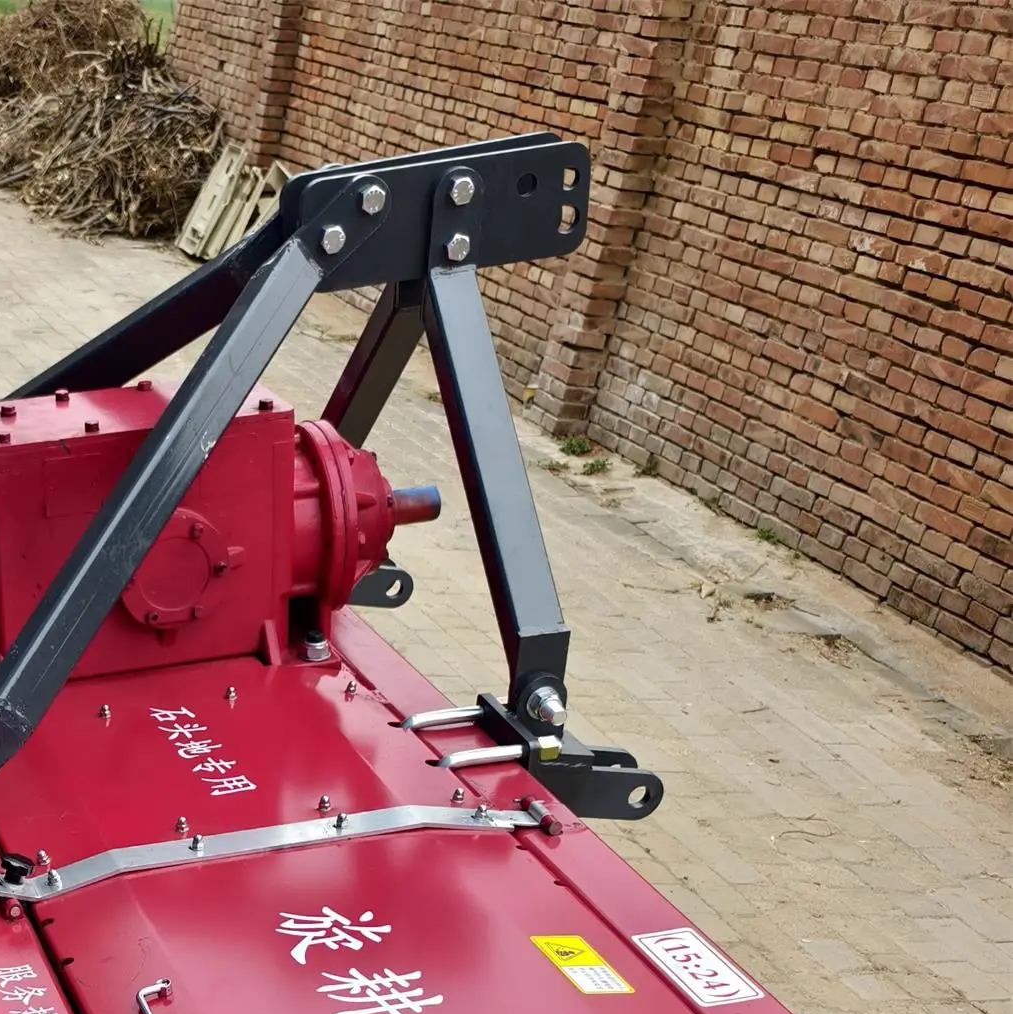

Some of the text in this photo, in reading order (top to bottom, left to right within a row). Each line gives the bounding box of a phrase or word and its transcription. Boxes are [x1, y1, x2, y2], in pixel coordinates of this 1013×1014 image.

[149, 706, 257, 796] 石头地专用
